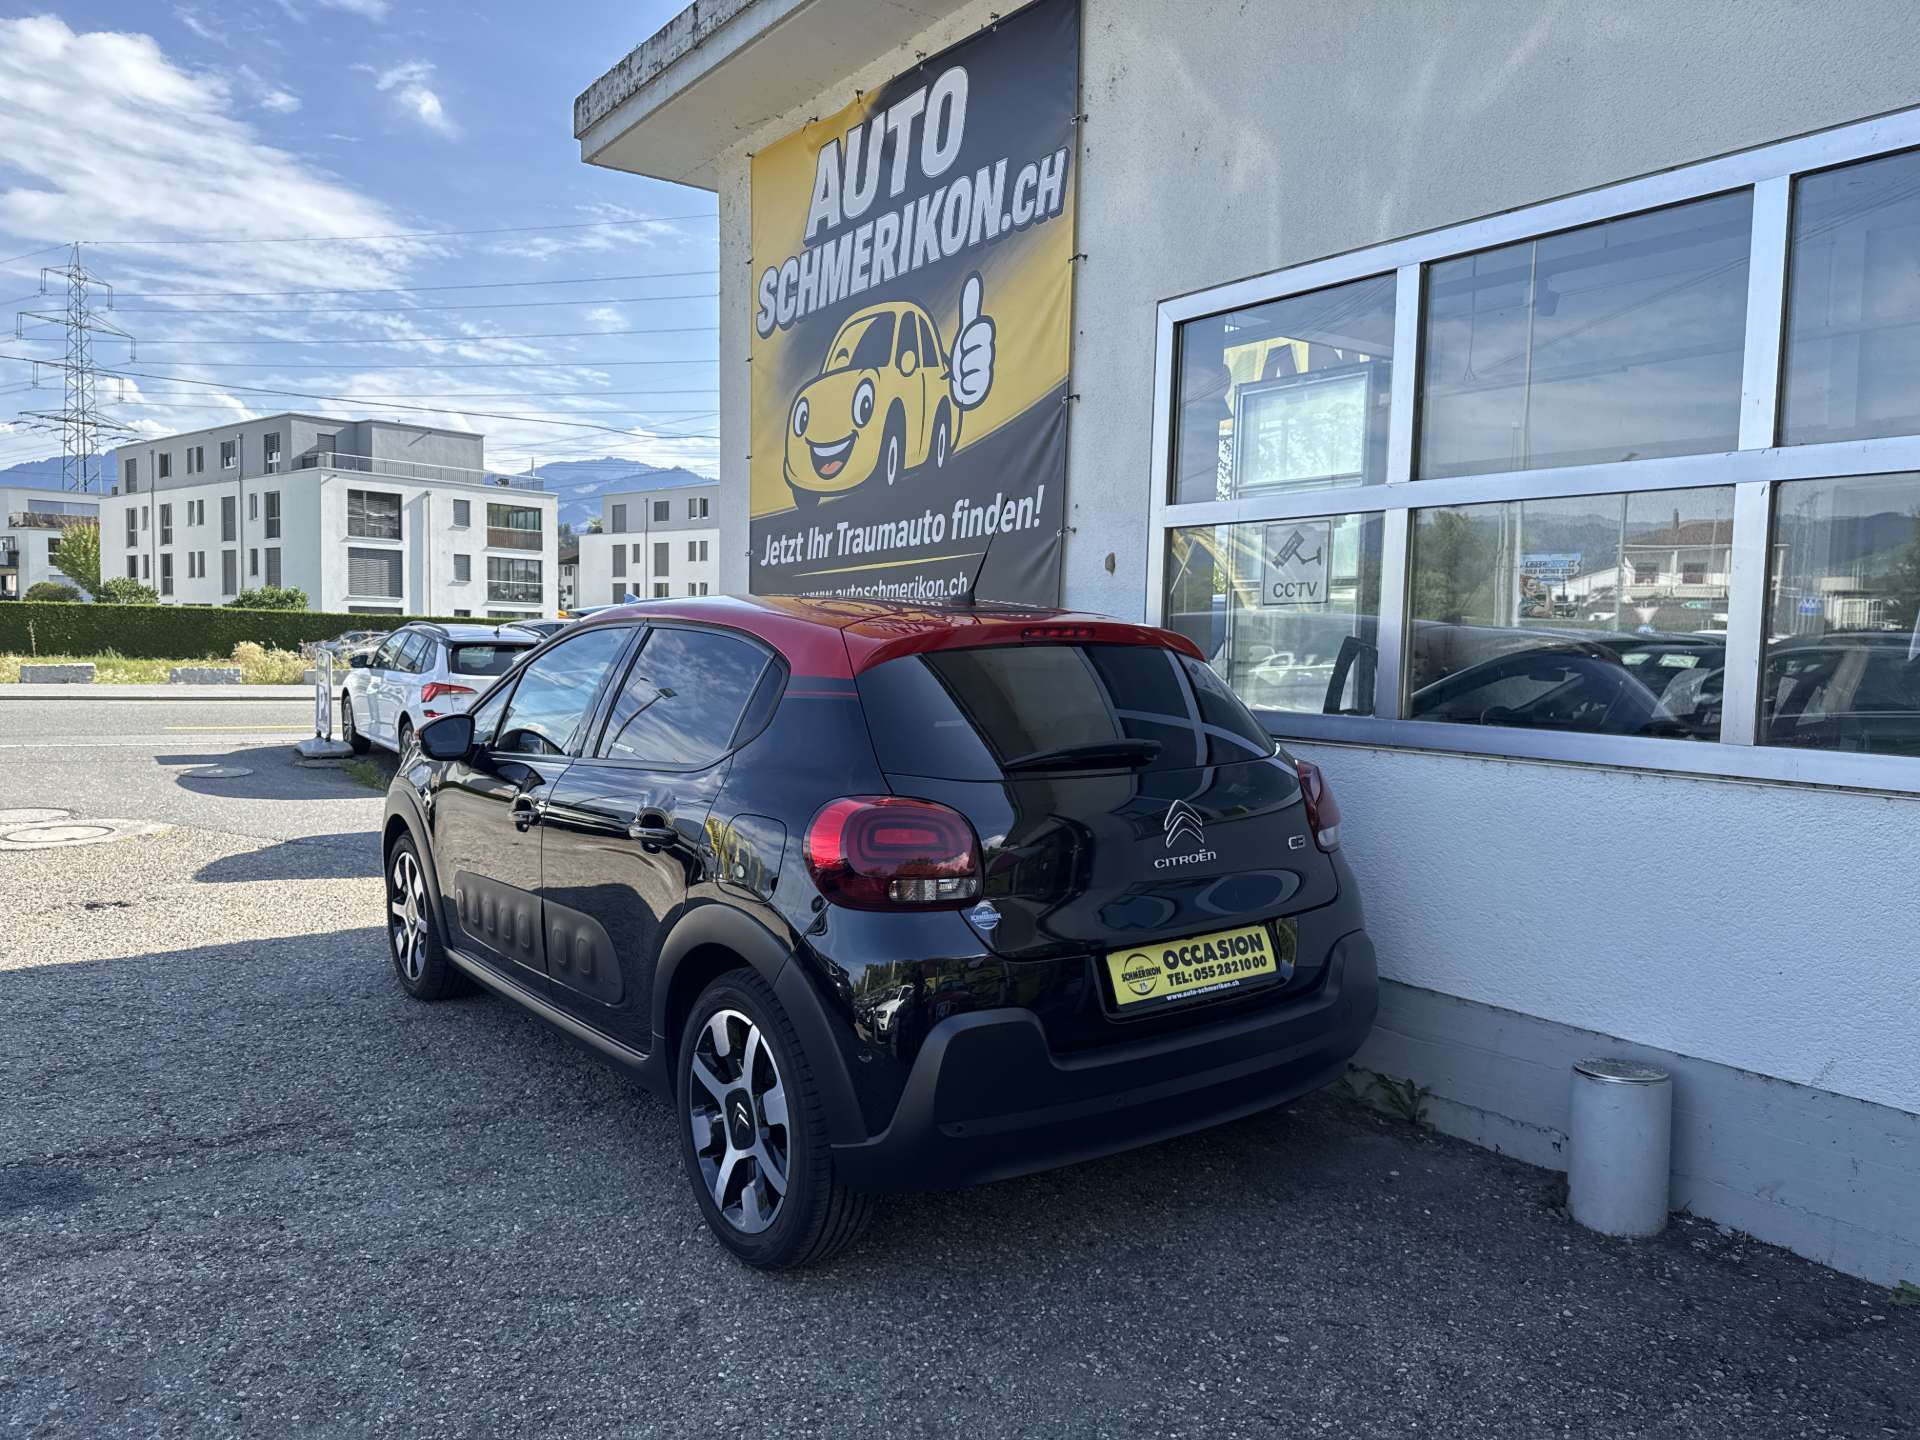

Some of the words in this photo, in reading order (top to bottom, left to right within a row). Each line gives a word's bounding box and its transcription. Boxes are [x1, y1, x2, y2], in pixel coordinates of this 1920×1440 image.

[805, 66, 968, 241] AUTO
[757, 148, 1068, 335] SCHMERIKON.CH
[760, 533, 804, 567] Jetzt
[807, 527, 833, 560] Ihr
[836, 508, 946, 556] Traumauto
[951, 485, 1045, 541] finden!
[802, 571, 968, 599] toschmerikon.ch
[1272, 581, 1318, 598] CCTV
[1162, 932, 1265, 970] OCCASION
